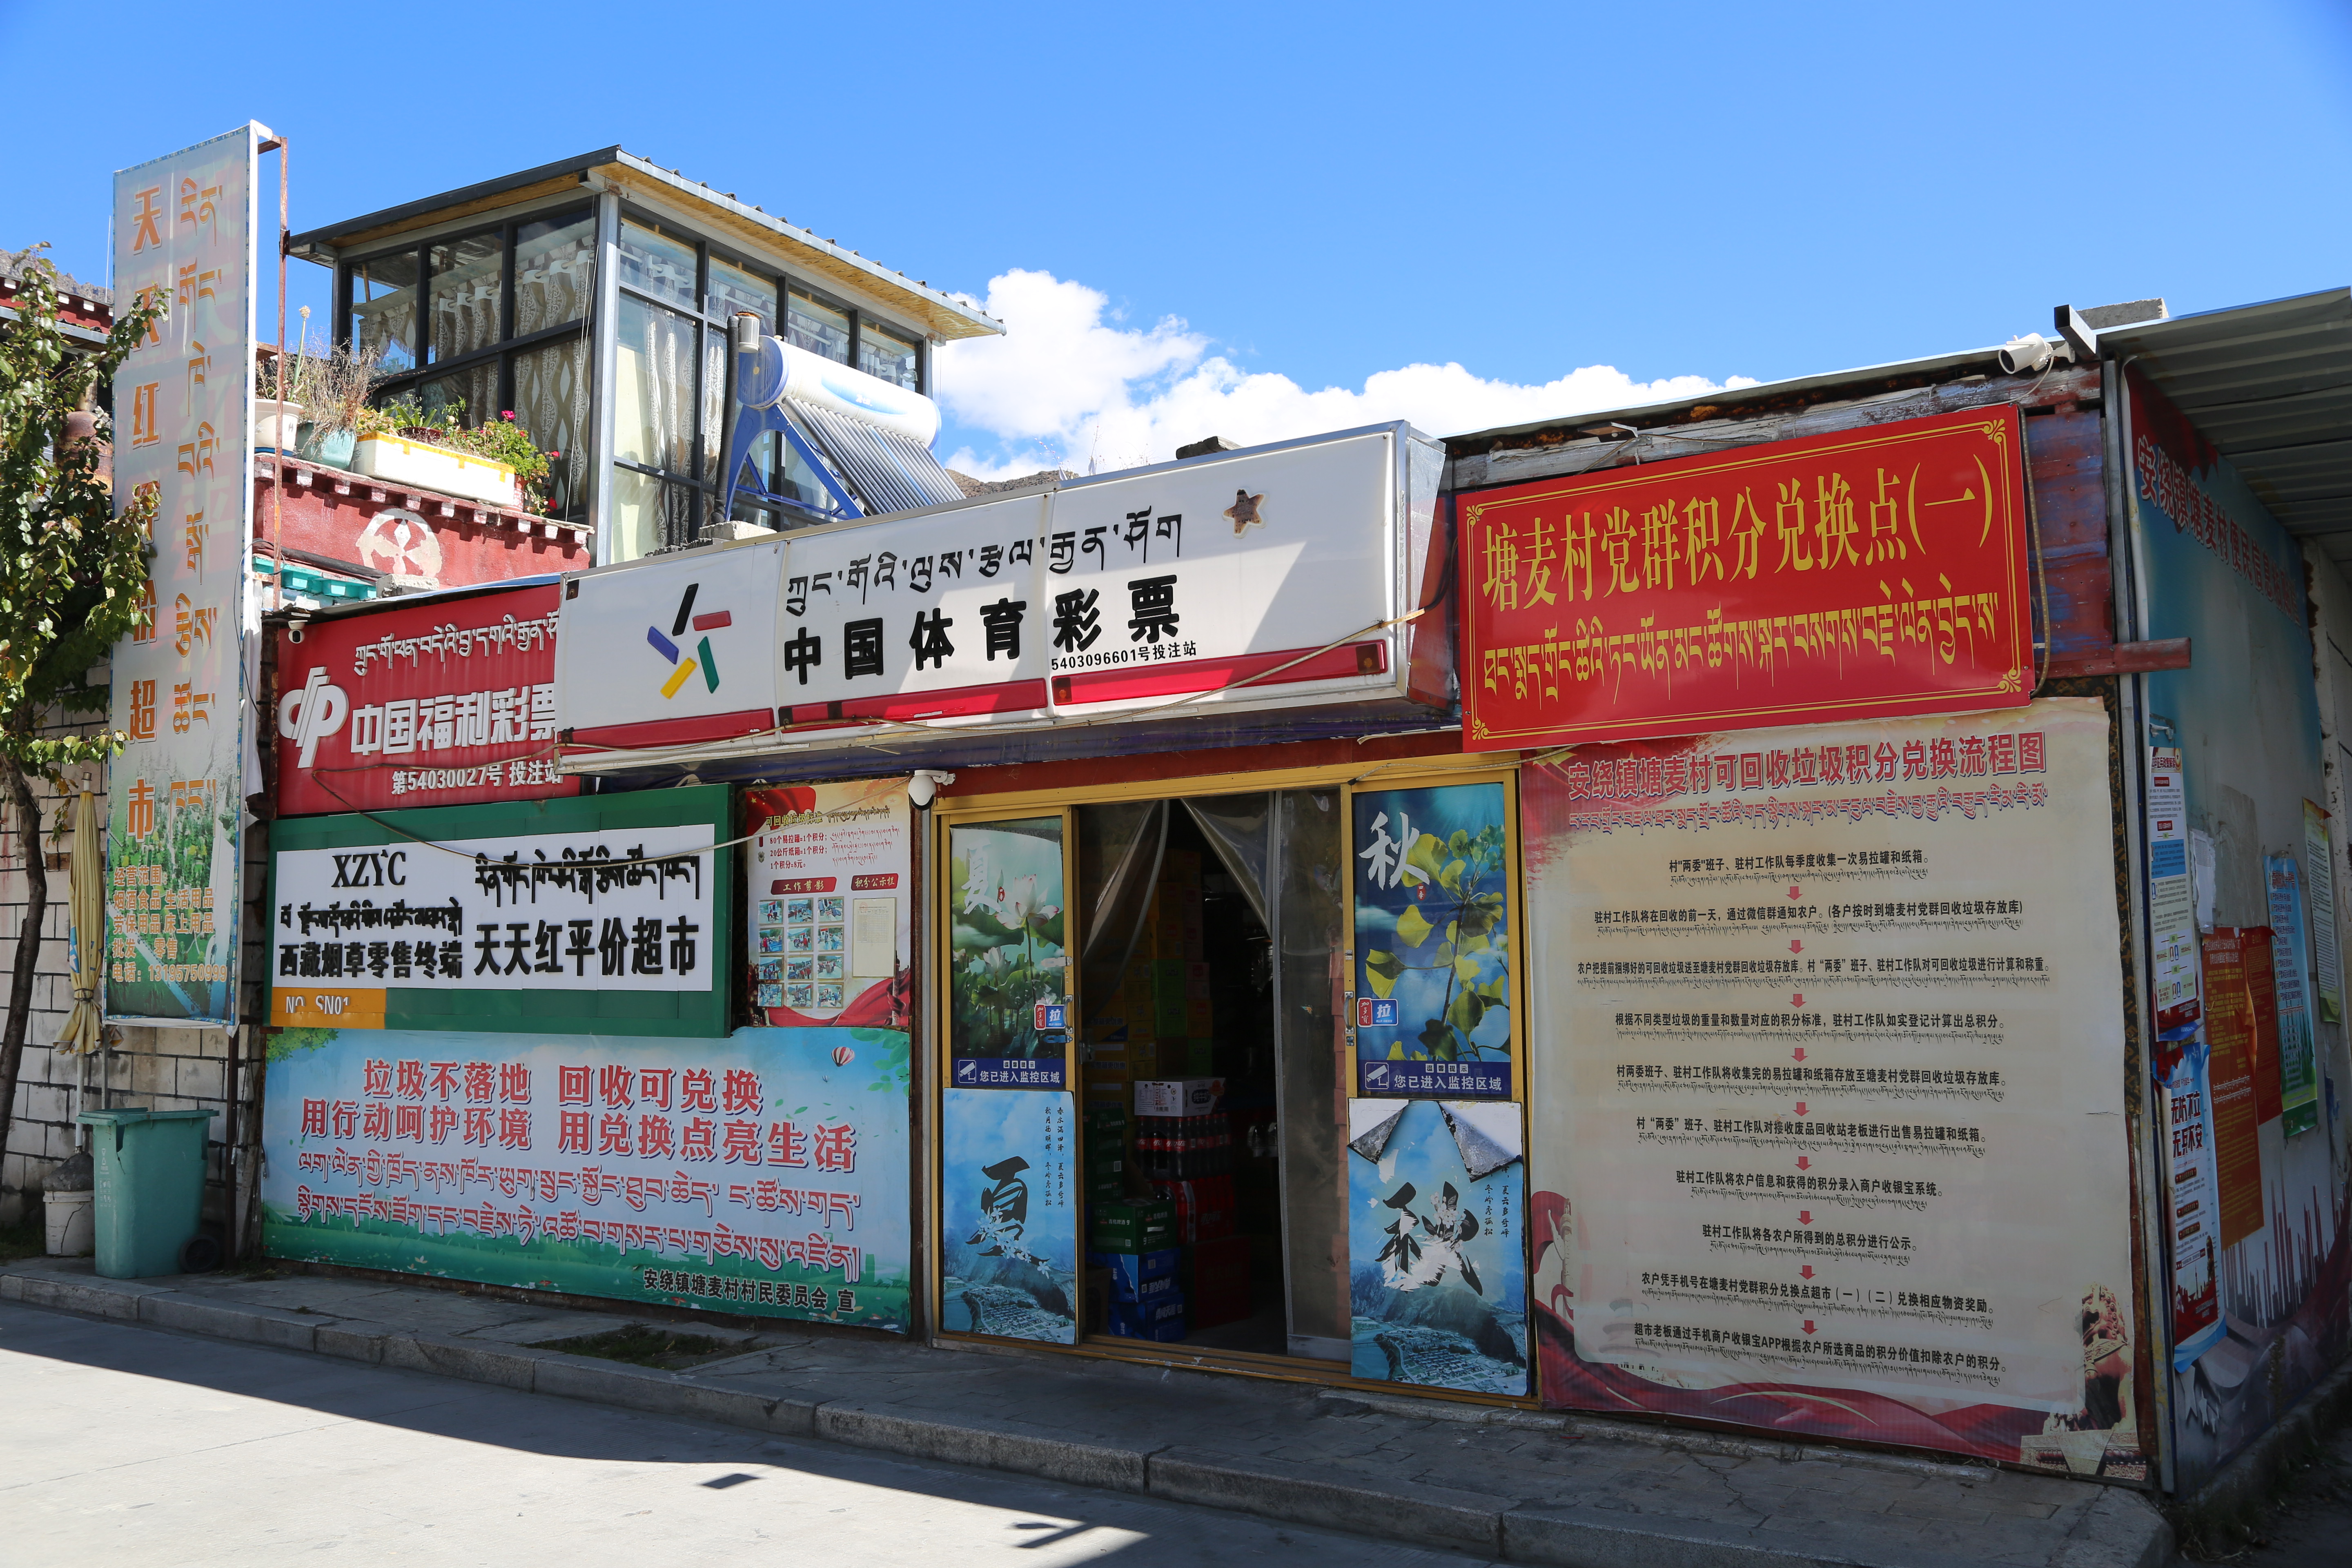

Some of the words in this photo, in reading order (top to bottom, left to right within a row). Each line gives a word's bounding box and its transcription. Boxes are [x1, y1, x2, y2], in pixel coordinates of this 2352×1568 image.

[784, 574, 1179, 685] 中国体育彩票
[1051, 640, 1197, 671] 5403096601号投注站
[351, 682, 555, 755] 中国福利彩票
[392, 762, 504, 795] 第54030027号
[509, 759, 564, 788] 投注站
[1568, 730, 2047, 801] 安绕镇塘麦村可回收垃圾积分兑换流程图
[766, 811, 823, 826] 可回收垃圾标准
[1359, 811, 1430, 891] 秋
[114, 865, 168, 886] 经营范围：
[783, 880, 824, 892] 工作剪影
[854, 875, 895, 887] 积分公示栏
[114, 889, 161, 910] 烟酒食品
[165, 887, 214, 910] 生活用品
[113, 913, 161, 935] 劳保用品
[164, 912, 214, 934] 床上用品
[112, 938, 136, 959] 批发
[154, 938, 178, 959] 零售
[279, 940, 462, 979] 西藏烟草零售终端
[474, 915, 699, 977] 天天红平价超市
[112, 962, 141, 982] 电话：
[148, 964, 227, 982] 13195750999
[1049, 1009, 1061, 1022] 拉
[1376, 1003, 1391, 1018] 拉
[980, 1071, 1060, 1084] 您已进入监控区域
[1394, 1075, 1502, 1091] 您已进入监控区域
[1425, 1063, 1469, 1074] 温馨提示
[364, 1058, 531, 1104] 垃圾不落地
[559, 1064, 763, 1115] 回收可兑换
[2171, 1090, 2201, 1126] 无防不立
[300, 1097, 531, 1151] 用行动呵护环境
[557, 1110, 856, 1172] 用兑换点亮生活
[2172, 1122, 2203, 1159] 无兵不安
[965, 1156, 1051, 1263] 夏
[644, 1268, 828, 1310] 安绕镇塘麦村村民委员会
[837, 1289, 855, 1313] 宣
